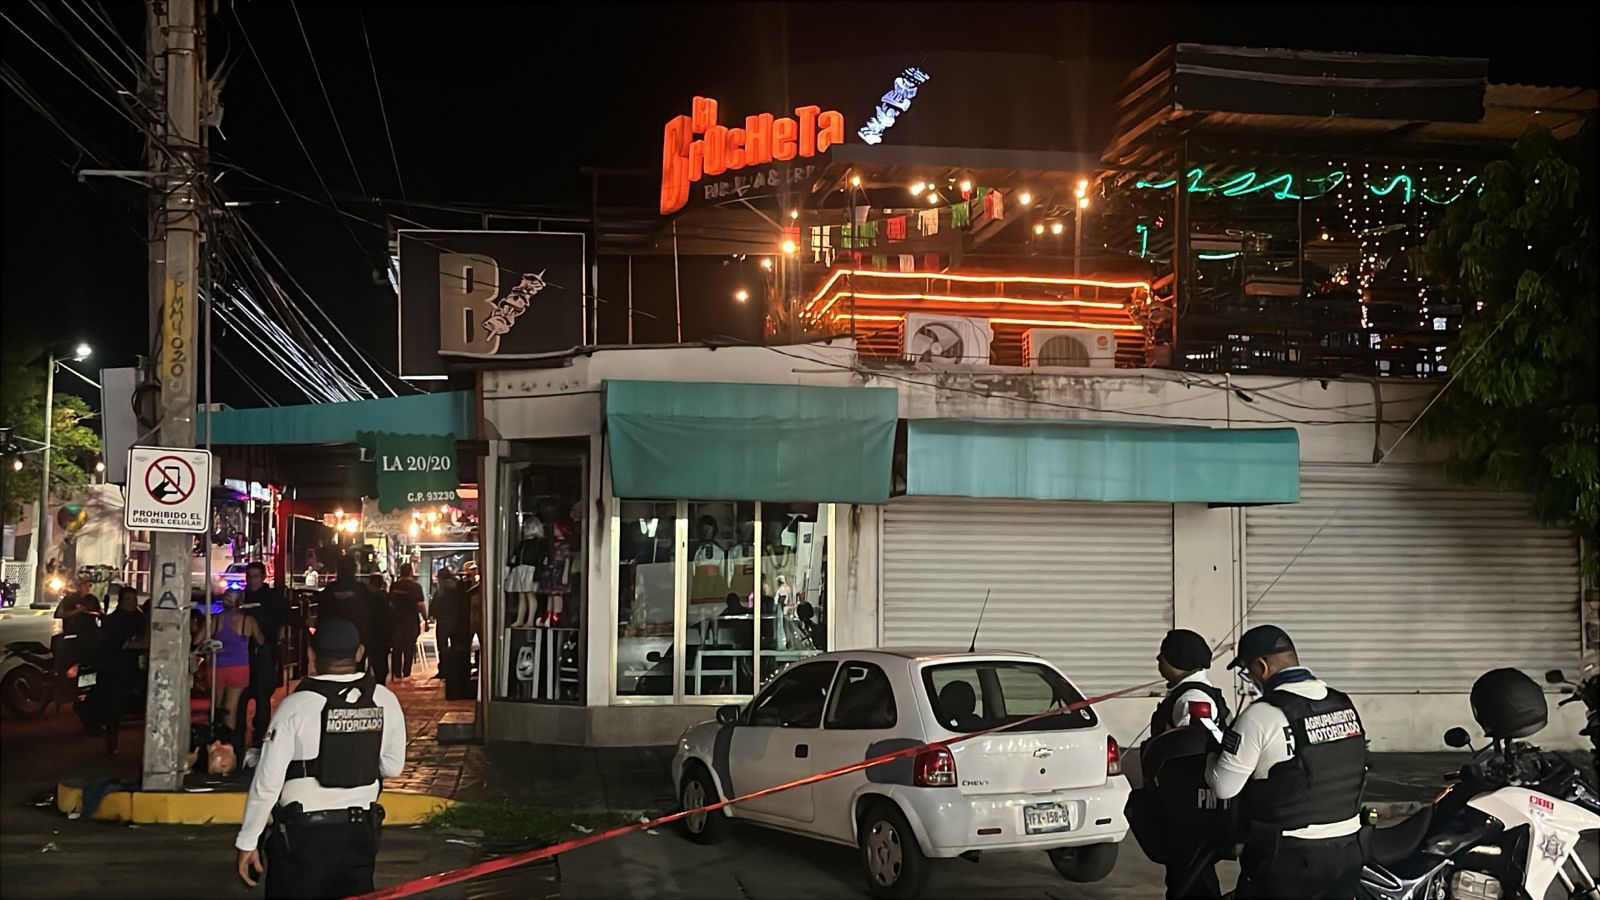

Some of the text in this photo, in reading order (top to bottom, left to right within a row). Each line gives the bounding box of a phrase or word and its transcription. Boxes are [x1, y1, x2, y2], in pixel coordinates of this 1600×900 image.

[383, 455, 451, 472] LA 20/20
[407, 491, 455, 502] C.P. 93230
[133, 509, 202, 520] PROHIBIDO EL
[167, 518, 202, 526] CELULAR
[328, 707, 384, 719] AGRUPAMIENTO
[327, 718, 383, 731] MOTORIZADO
[1304, 708, 1357, 731] AGRUPAMIENTO
[1307, 721, 1360, 743] MOTORIZADO
